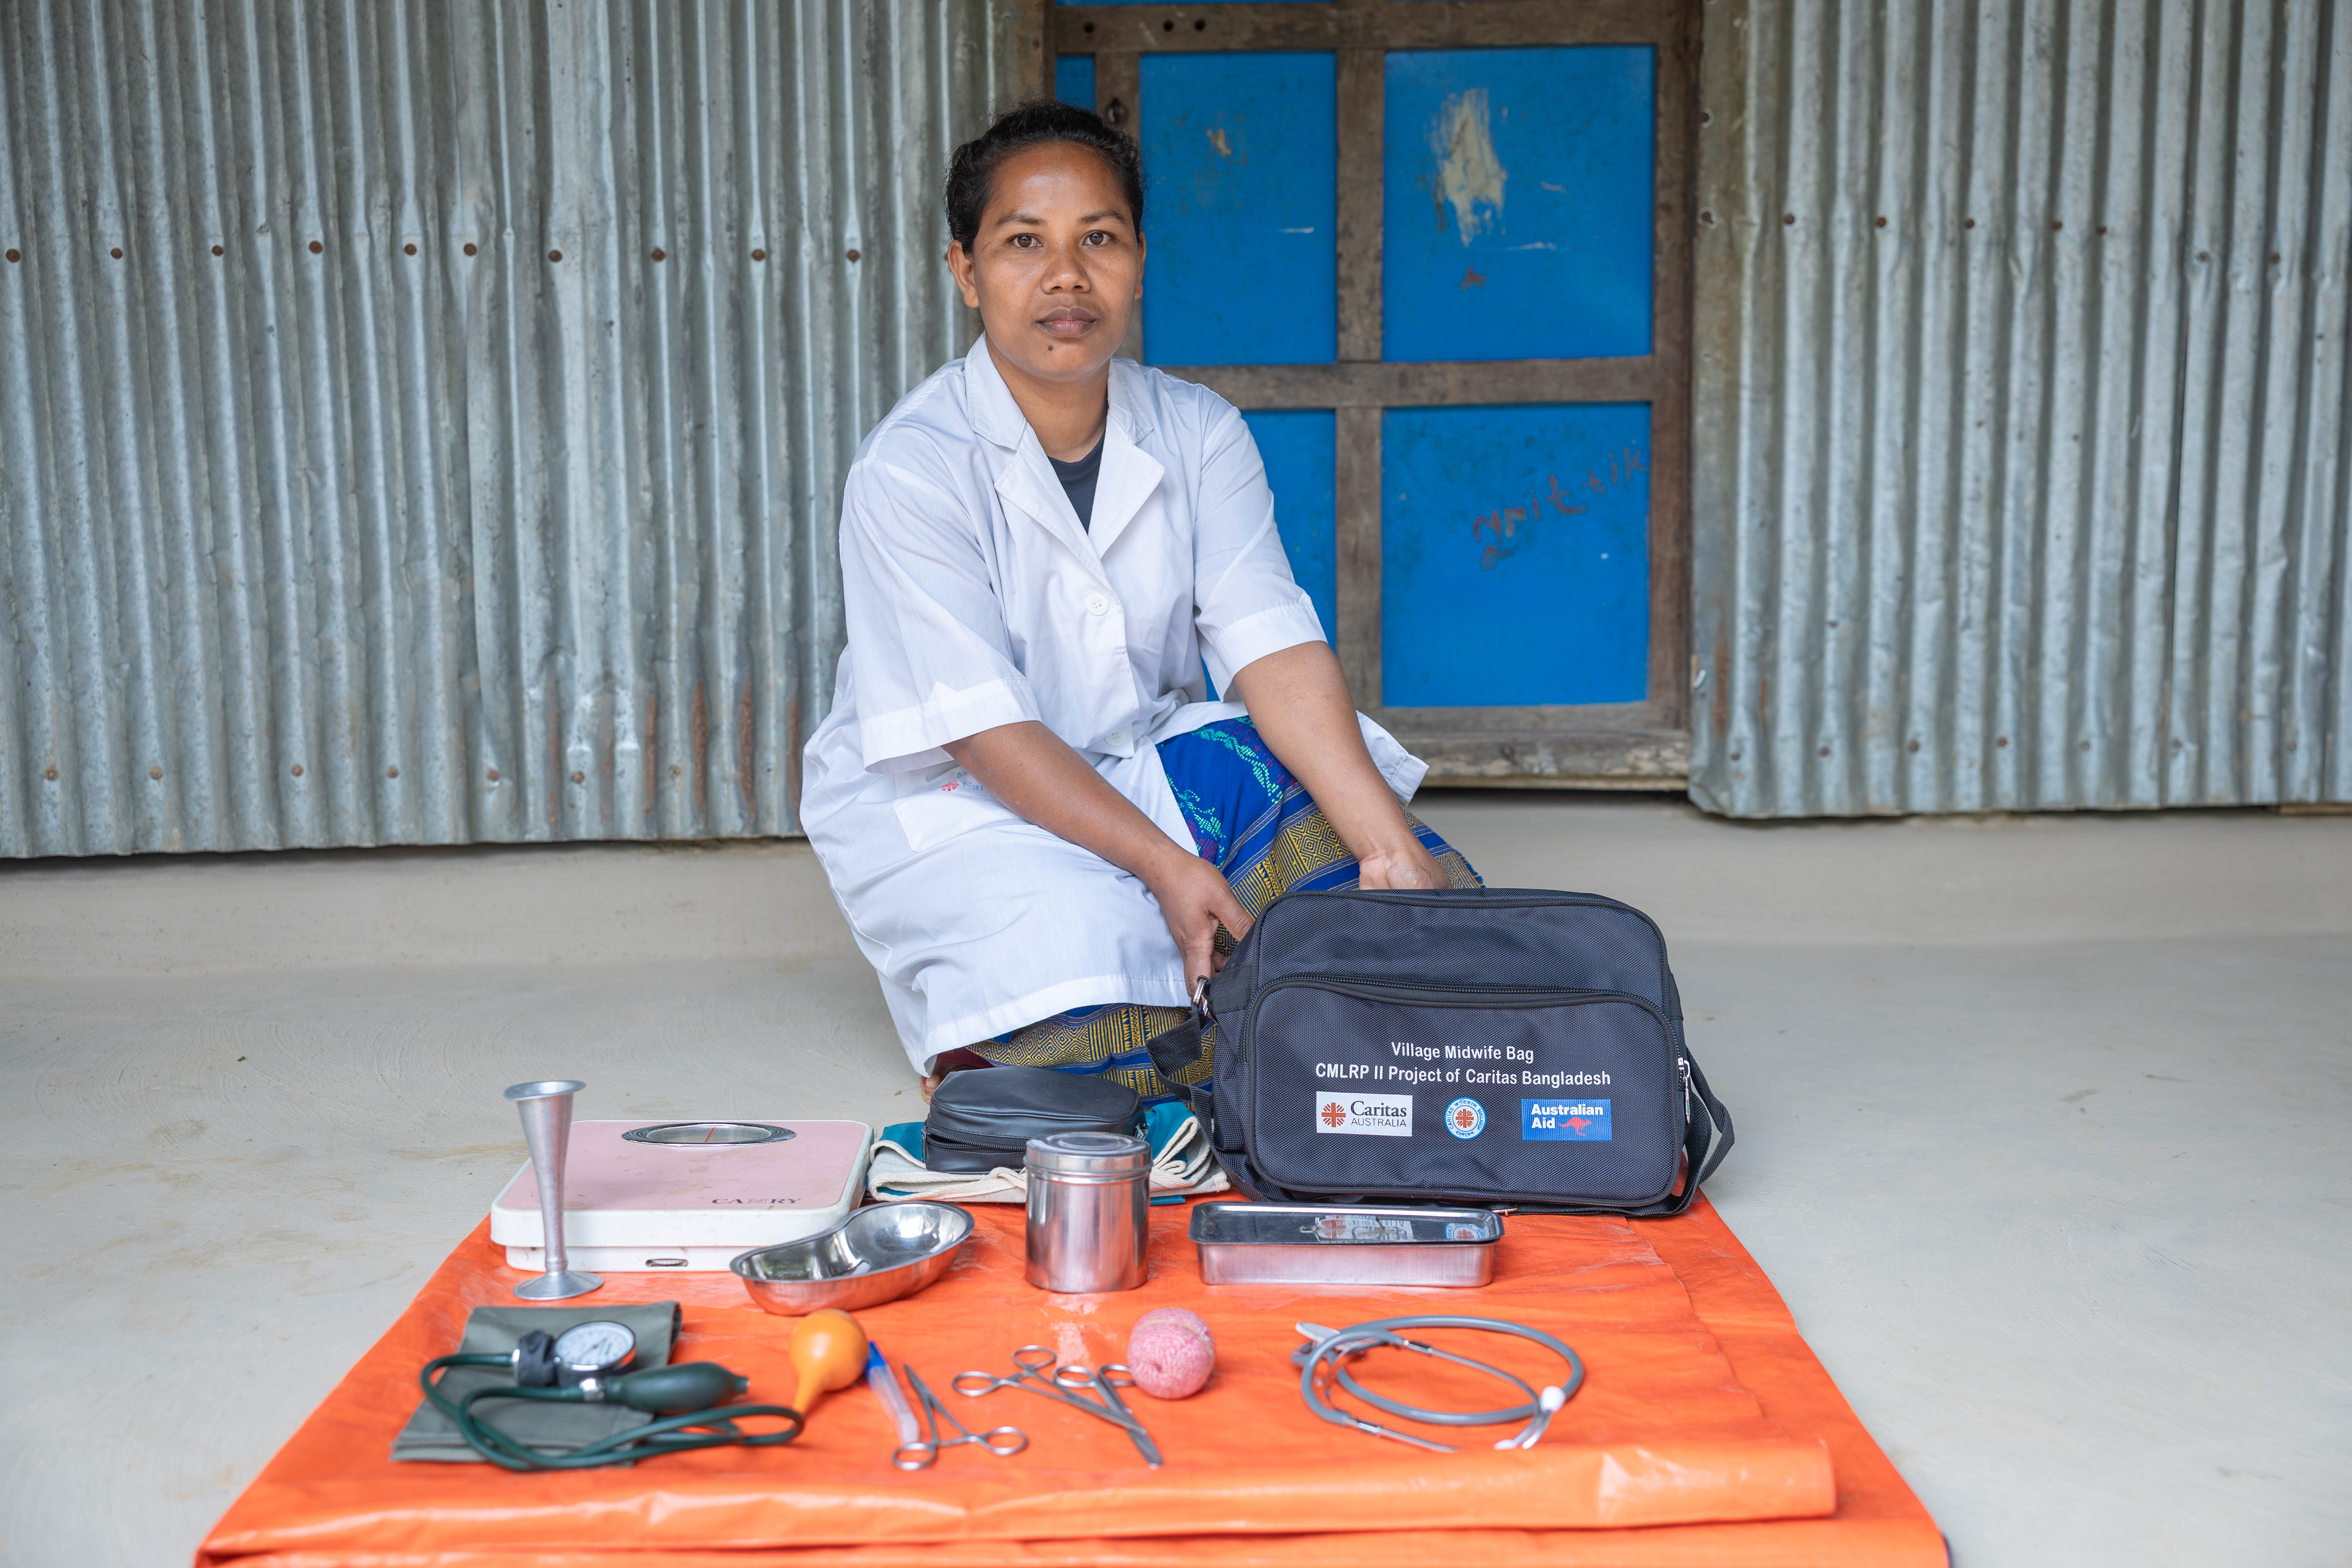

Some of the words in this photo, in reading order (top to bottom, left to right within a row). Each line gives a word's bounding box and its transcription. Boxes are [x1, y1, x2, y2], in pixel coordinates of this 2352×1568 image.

[1392, 1042, 1440, 1061] Village
[1445, 1045, 1501, 1059] Midwife
[1506, 1046, 1534, 1064] Bag
[1316, 1063, 1369, 1079] CMLRP
[1374, 1065, 1383, 1080] II
[1389, 1066, 1442, 1085] Project
[1446, 1068, 1460, 1083] of
[1466, 1069, 1517, 1085] Caritas
[1522, 1071, 1611, 1089] Bangladesh
[1350, 1100, 1407, 1117] Caritas
[1531, 1103, 1603, 1115] Australian
[1351, 1118, 1406, 1127] AUSTRALIA
[1532, 1117, 1555, 1129] Aid
